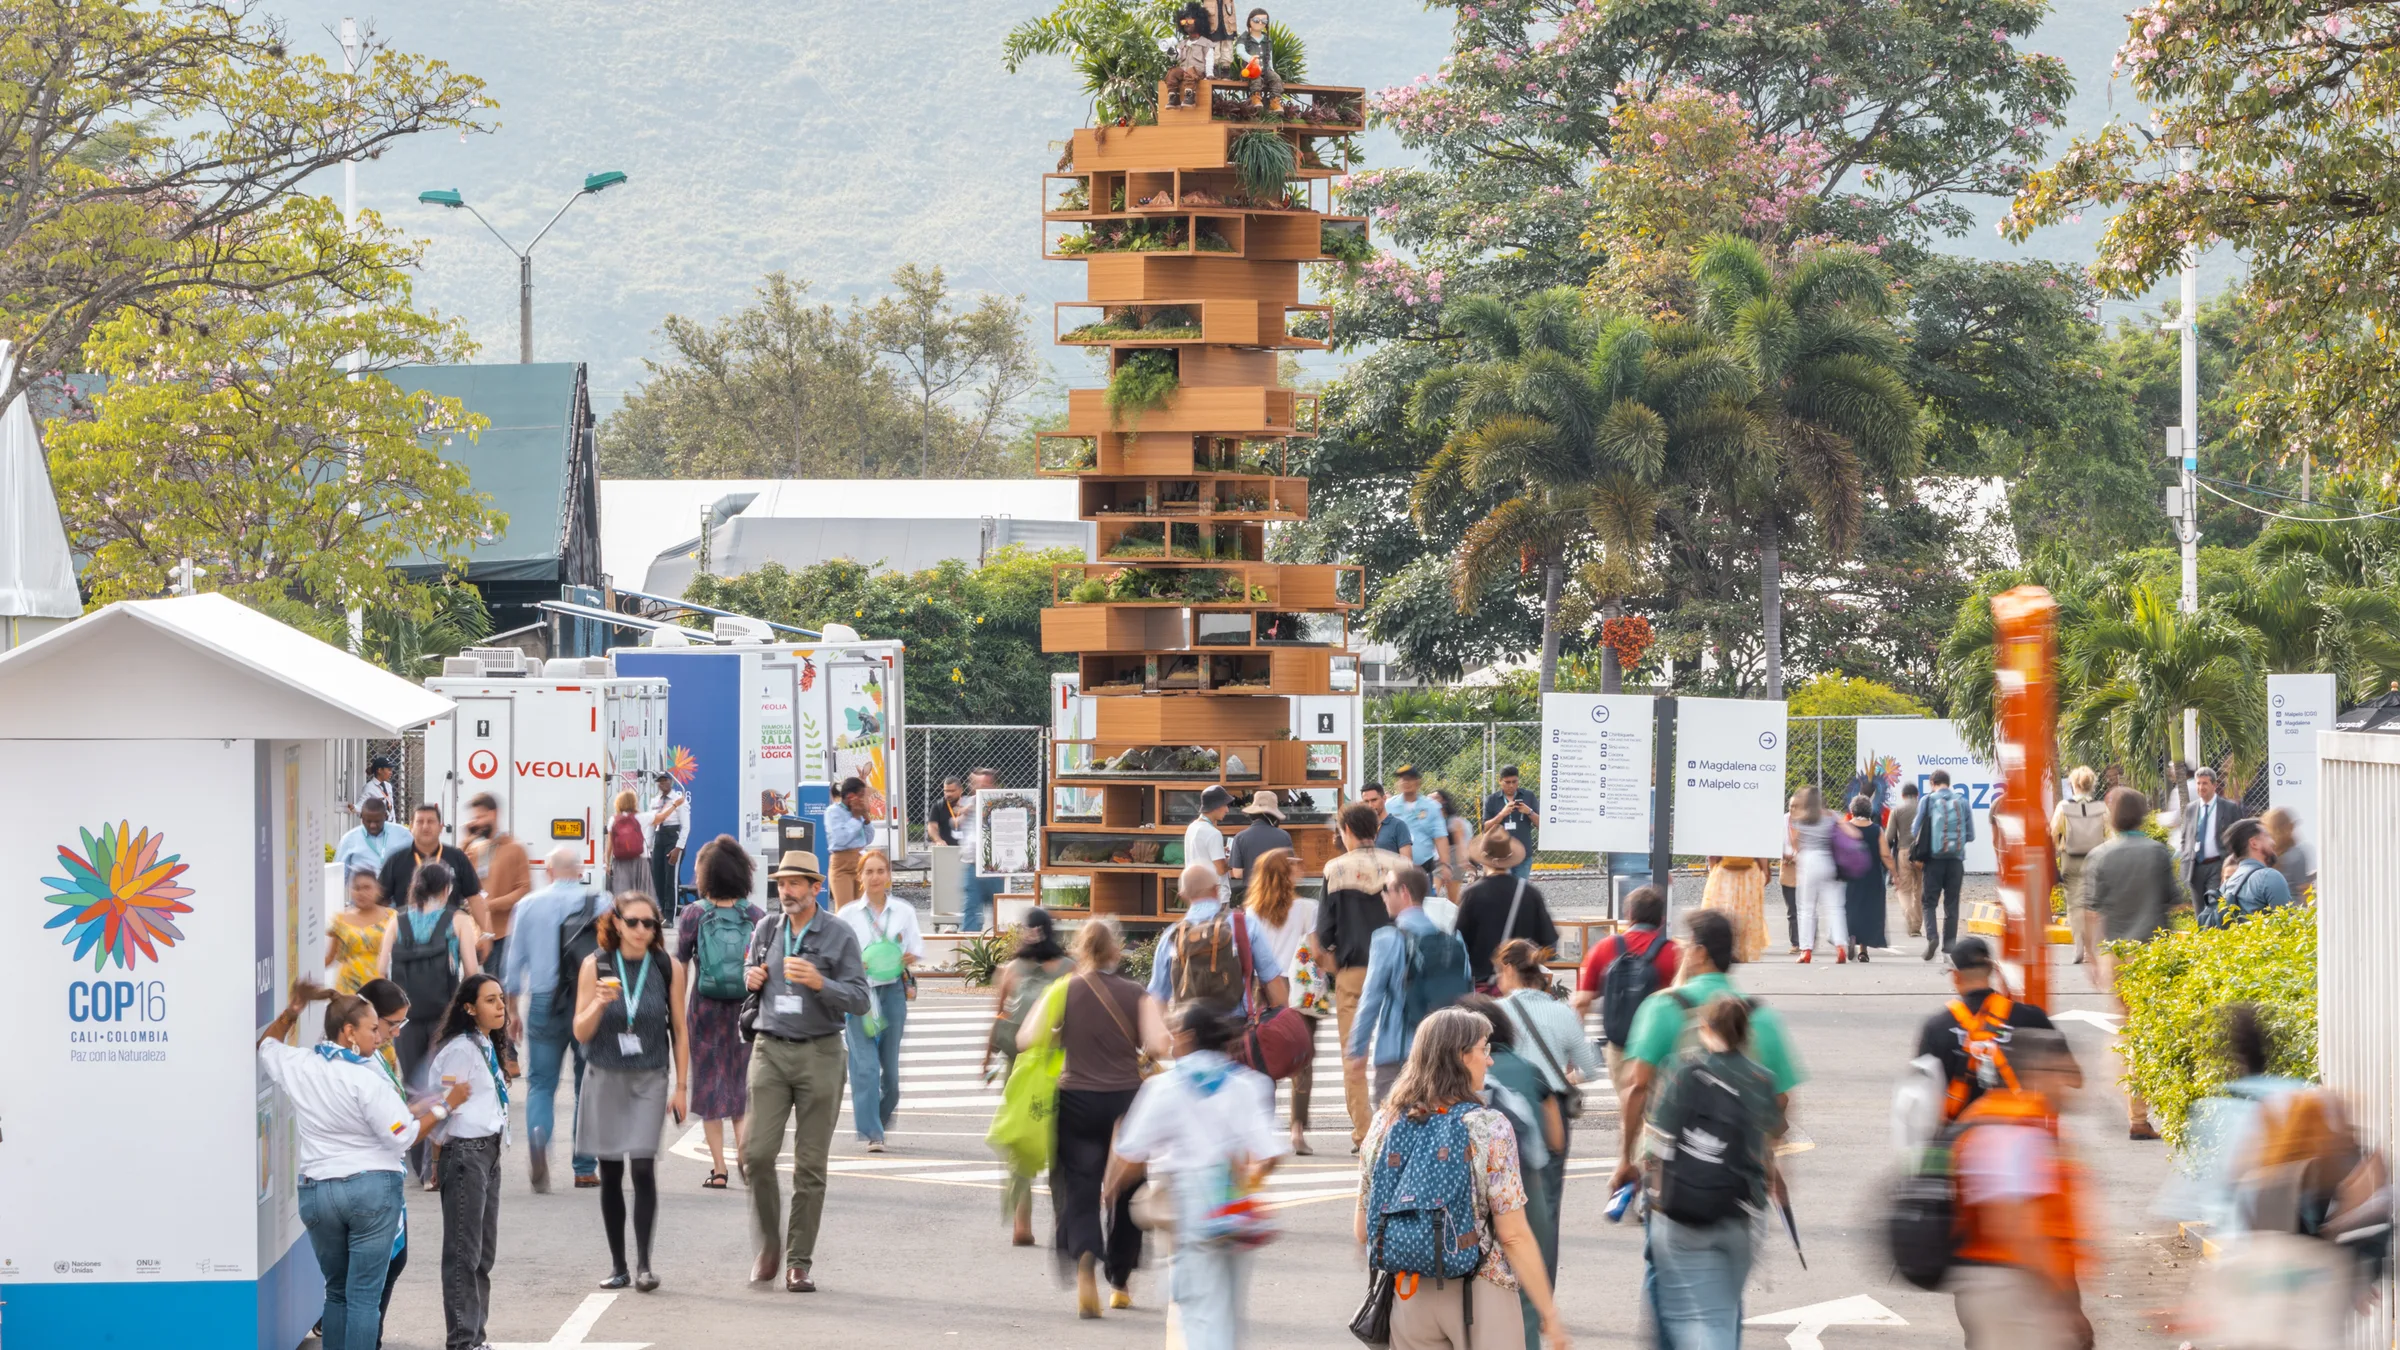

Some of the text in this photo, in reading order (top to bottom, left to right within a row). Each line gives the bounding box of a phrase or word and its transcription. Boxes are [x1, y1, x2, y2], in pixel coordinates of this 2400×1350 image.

[778, 735, 792, 744] LA
[761, 750, 793, 759] LÓGICA
[1917, 754, 1969, 766] Welcome
[515, 761, 601, 779] VEOLIA
[1699, 760, 1777, 772] Magdalena CG2
[1698, 779, 1741, 790] Malpelo
[68, 980, 166, 1022] COP16
[70, 1049, 166, 1062] Paz con la Naturaleza
[71, 1260, 102, 1268] Naciones
